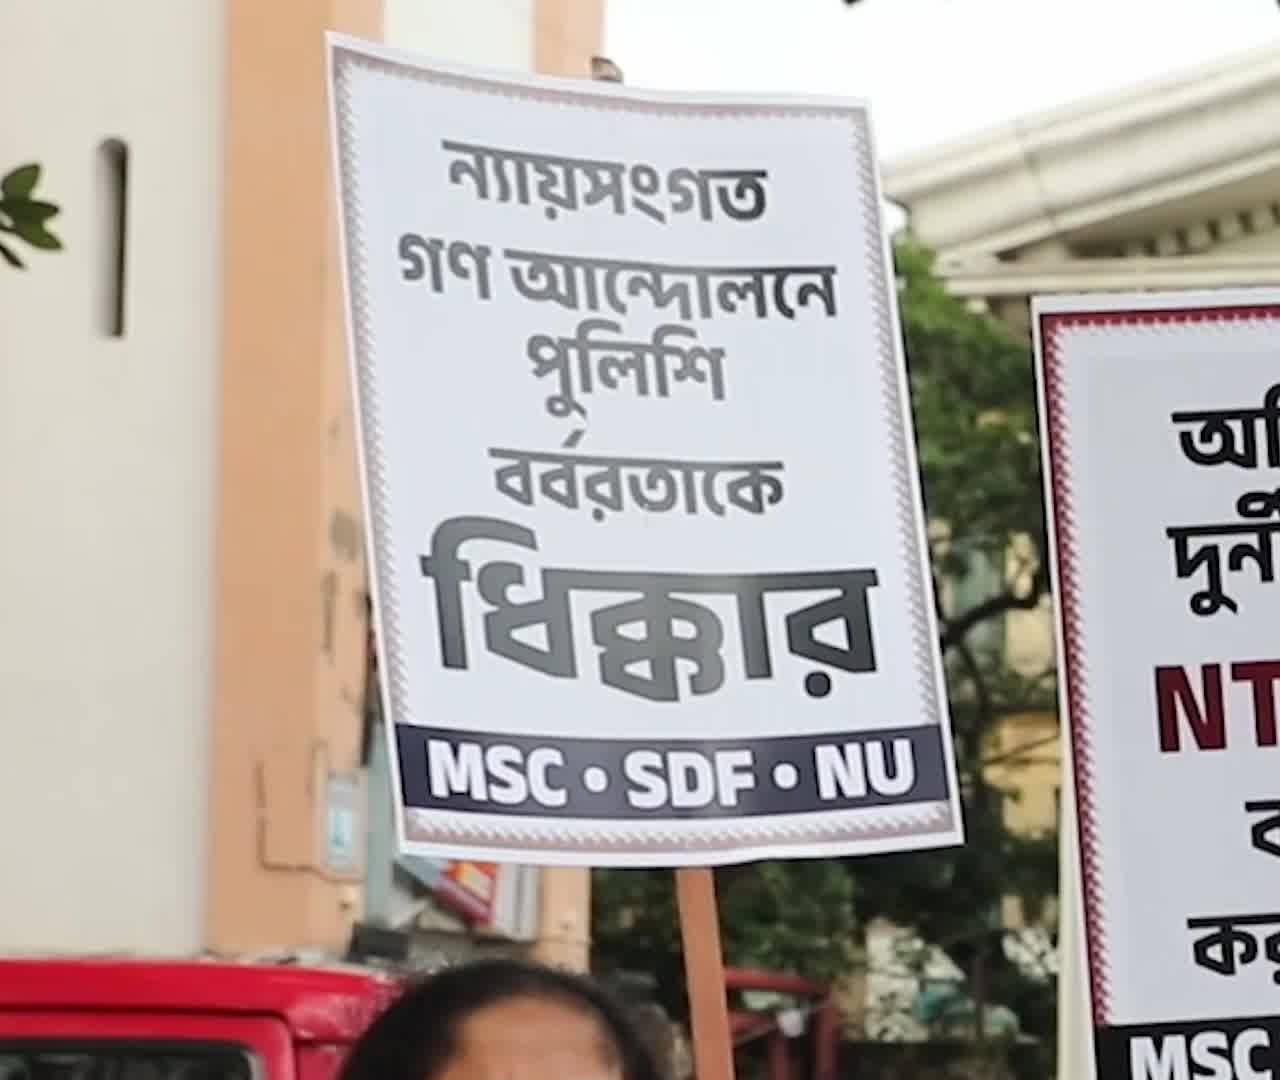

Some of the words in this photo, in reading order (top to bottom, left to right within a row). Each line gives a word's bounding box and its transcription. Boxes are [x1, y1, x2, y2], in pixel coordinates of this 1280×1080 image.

[442, 140, 768, 224] ন্যায়সংগত
[398, 233, 491, 299] গণ
[504, 249, 837, 320] আন্দোলনে
[527, 325, 725, 418] পুলিশি
[488, 430, 784, 522] বর্বরতাকে
[419, 516, 879, 702] ধিক্কার
[427, 738, 569, 808] MSC
[623, 749, 757, 810] SDF
[814, 737, 916, 801] NU
